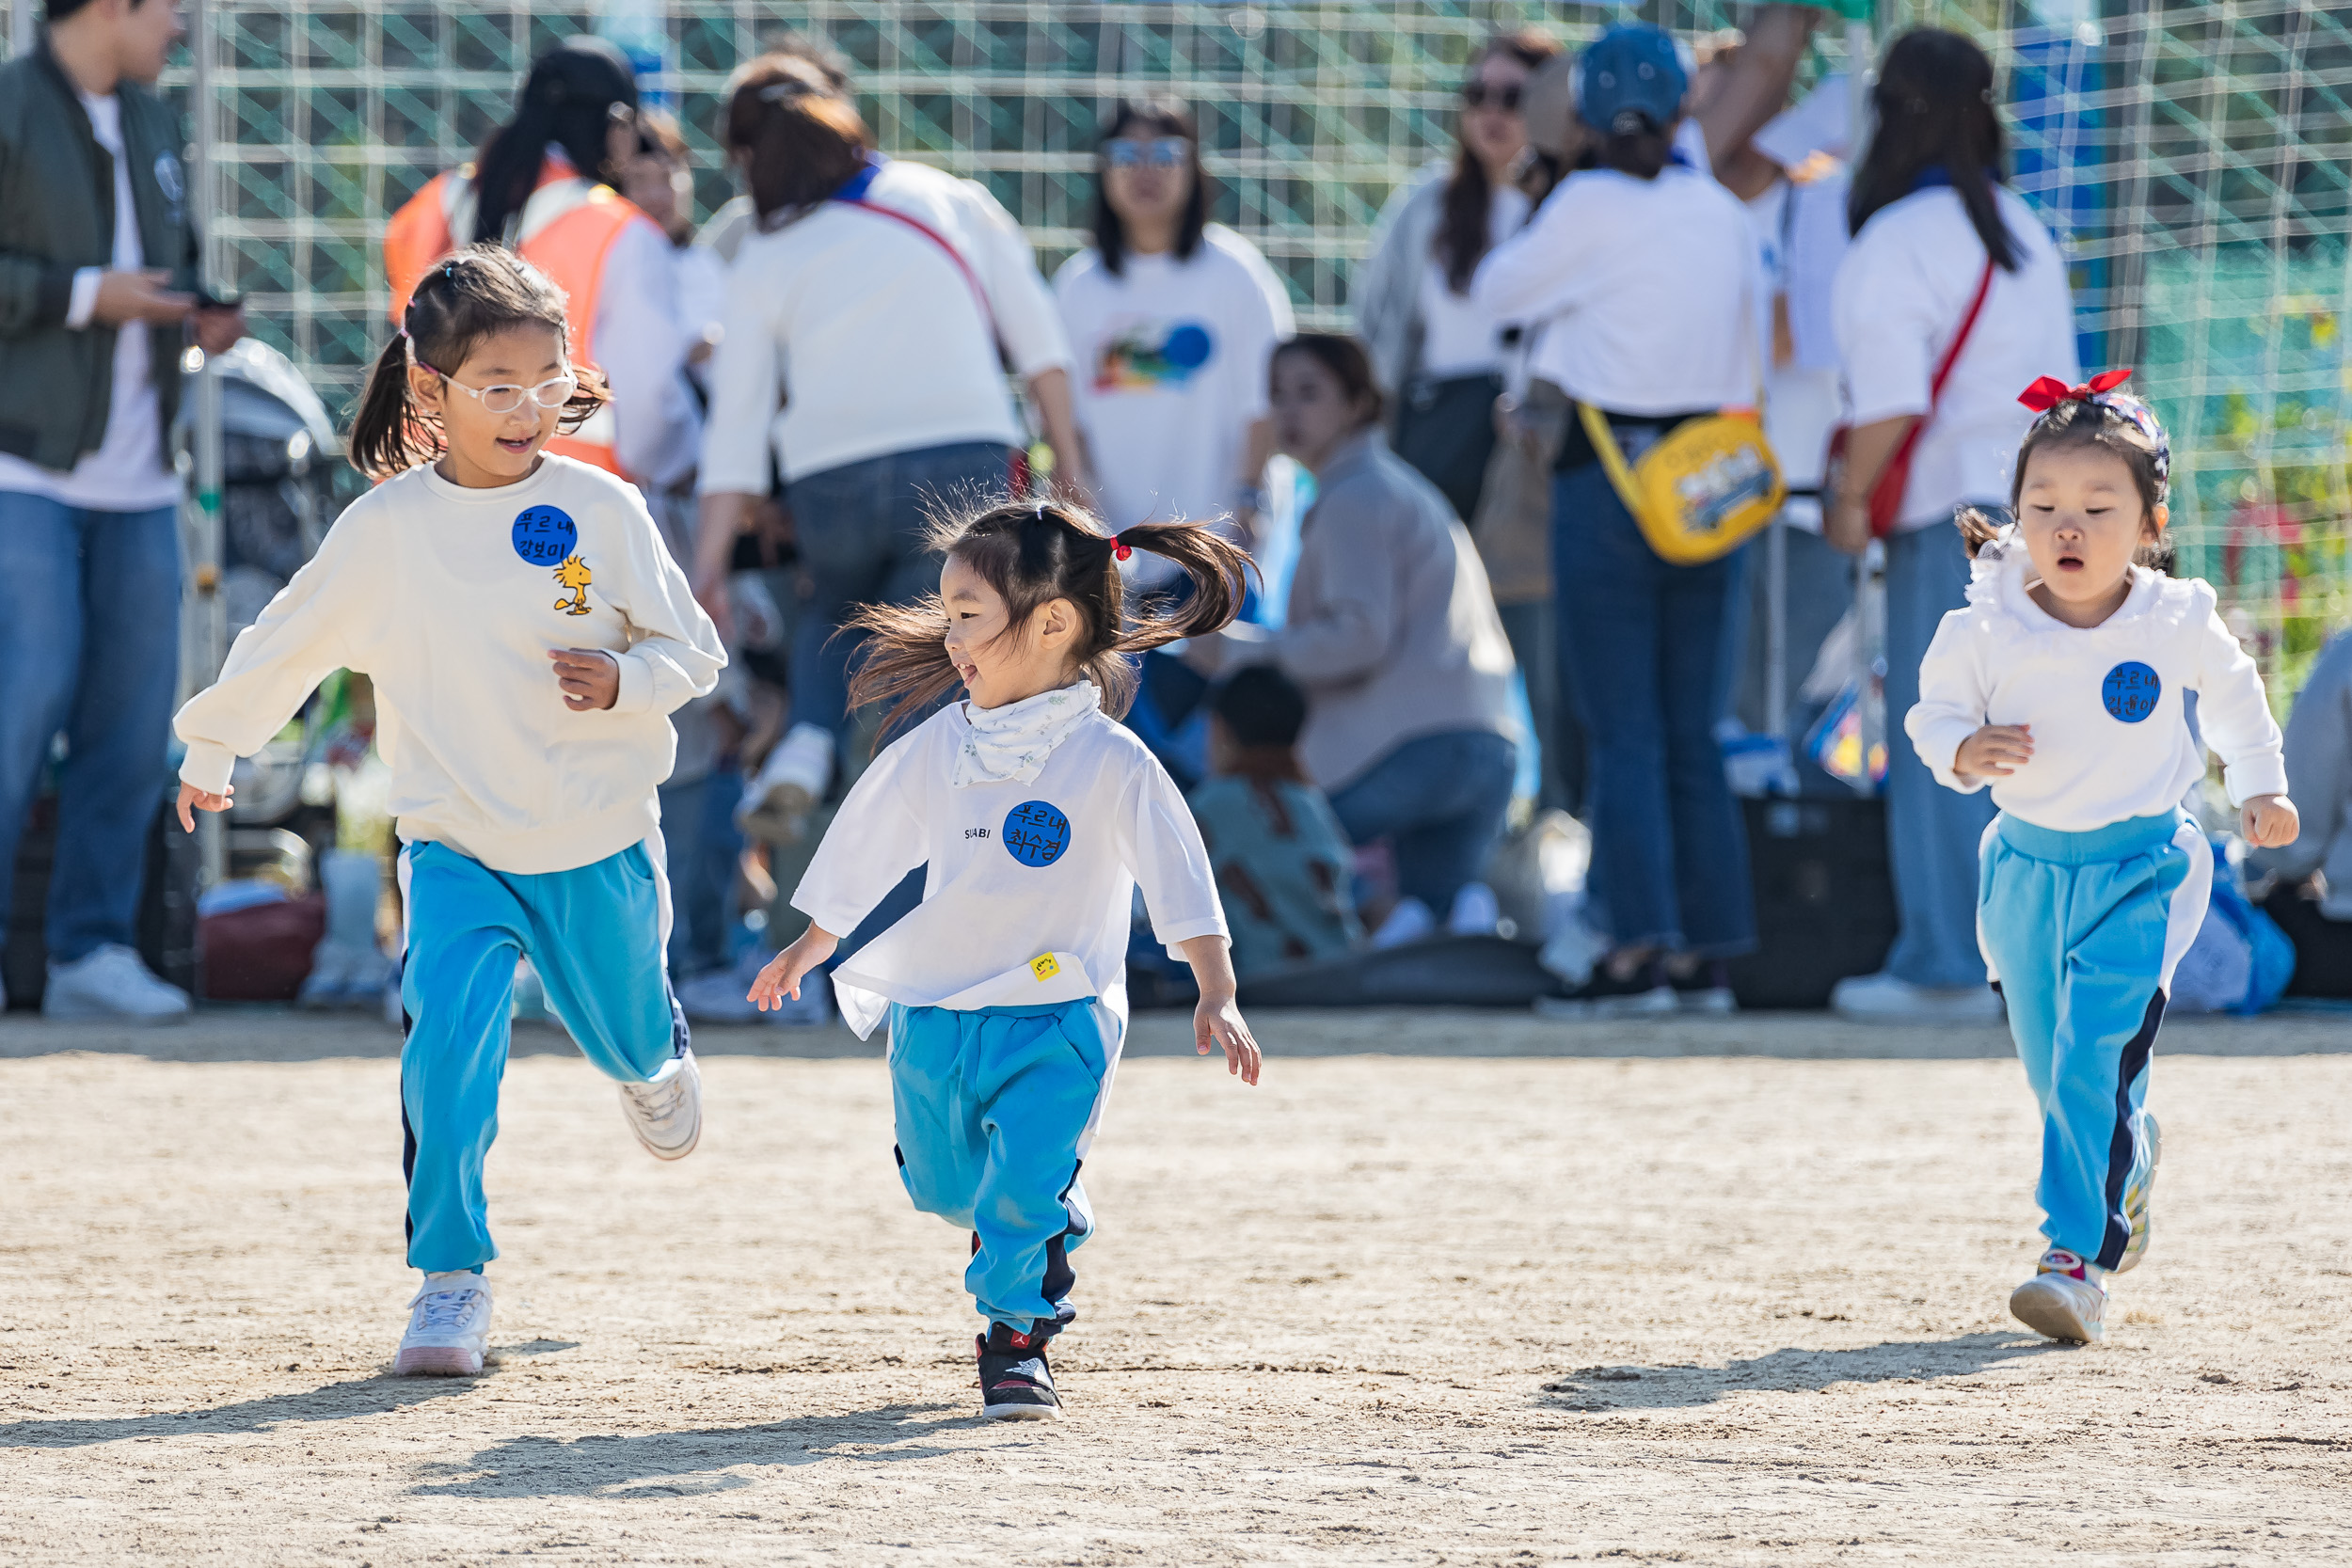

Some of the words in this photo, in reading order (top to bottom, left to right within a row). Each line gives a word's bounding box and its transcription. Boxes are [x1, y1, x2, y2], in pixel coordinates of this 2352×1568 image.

[516, 512, 574, 535] 푸르내
[519, 539, 565, 560] 강보미
[2106, 666, 2158, 689] 푸르내
[1012, 804, 1068, 839] 푸르내
